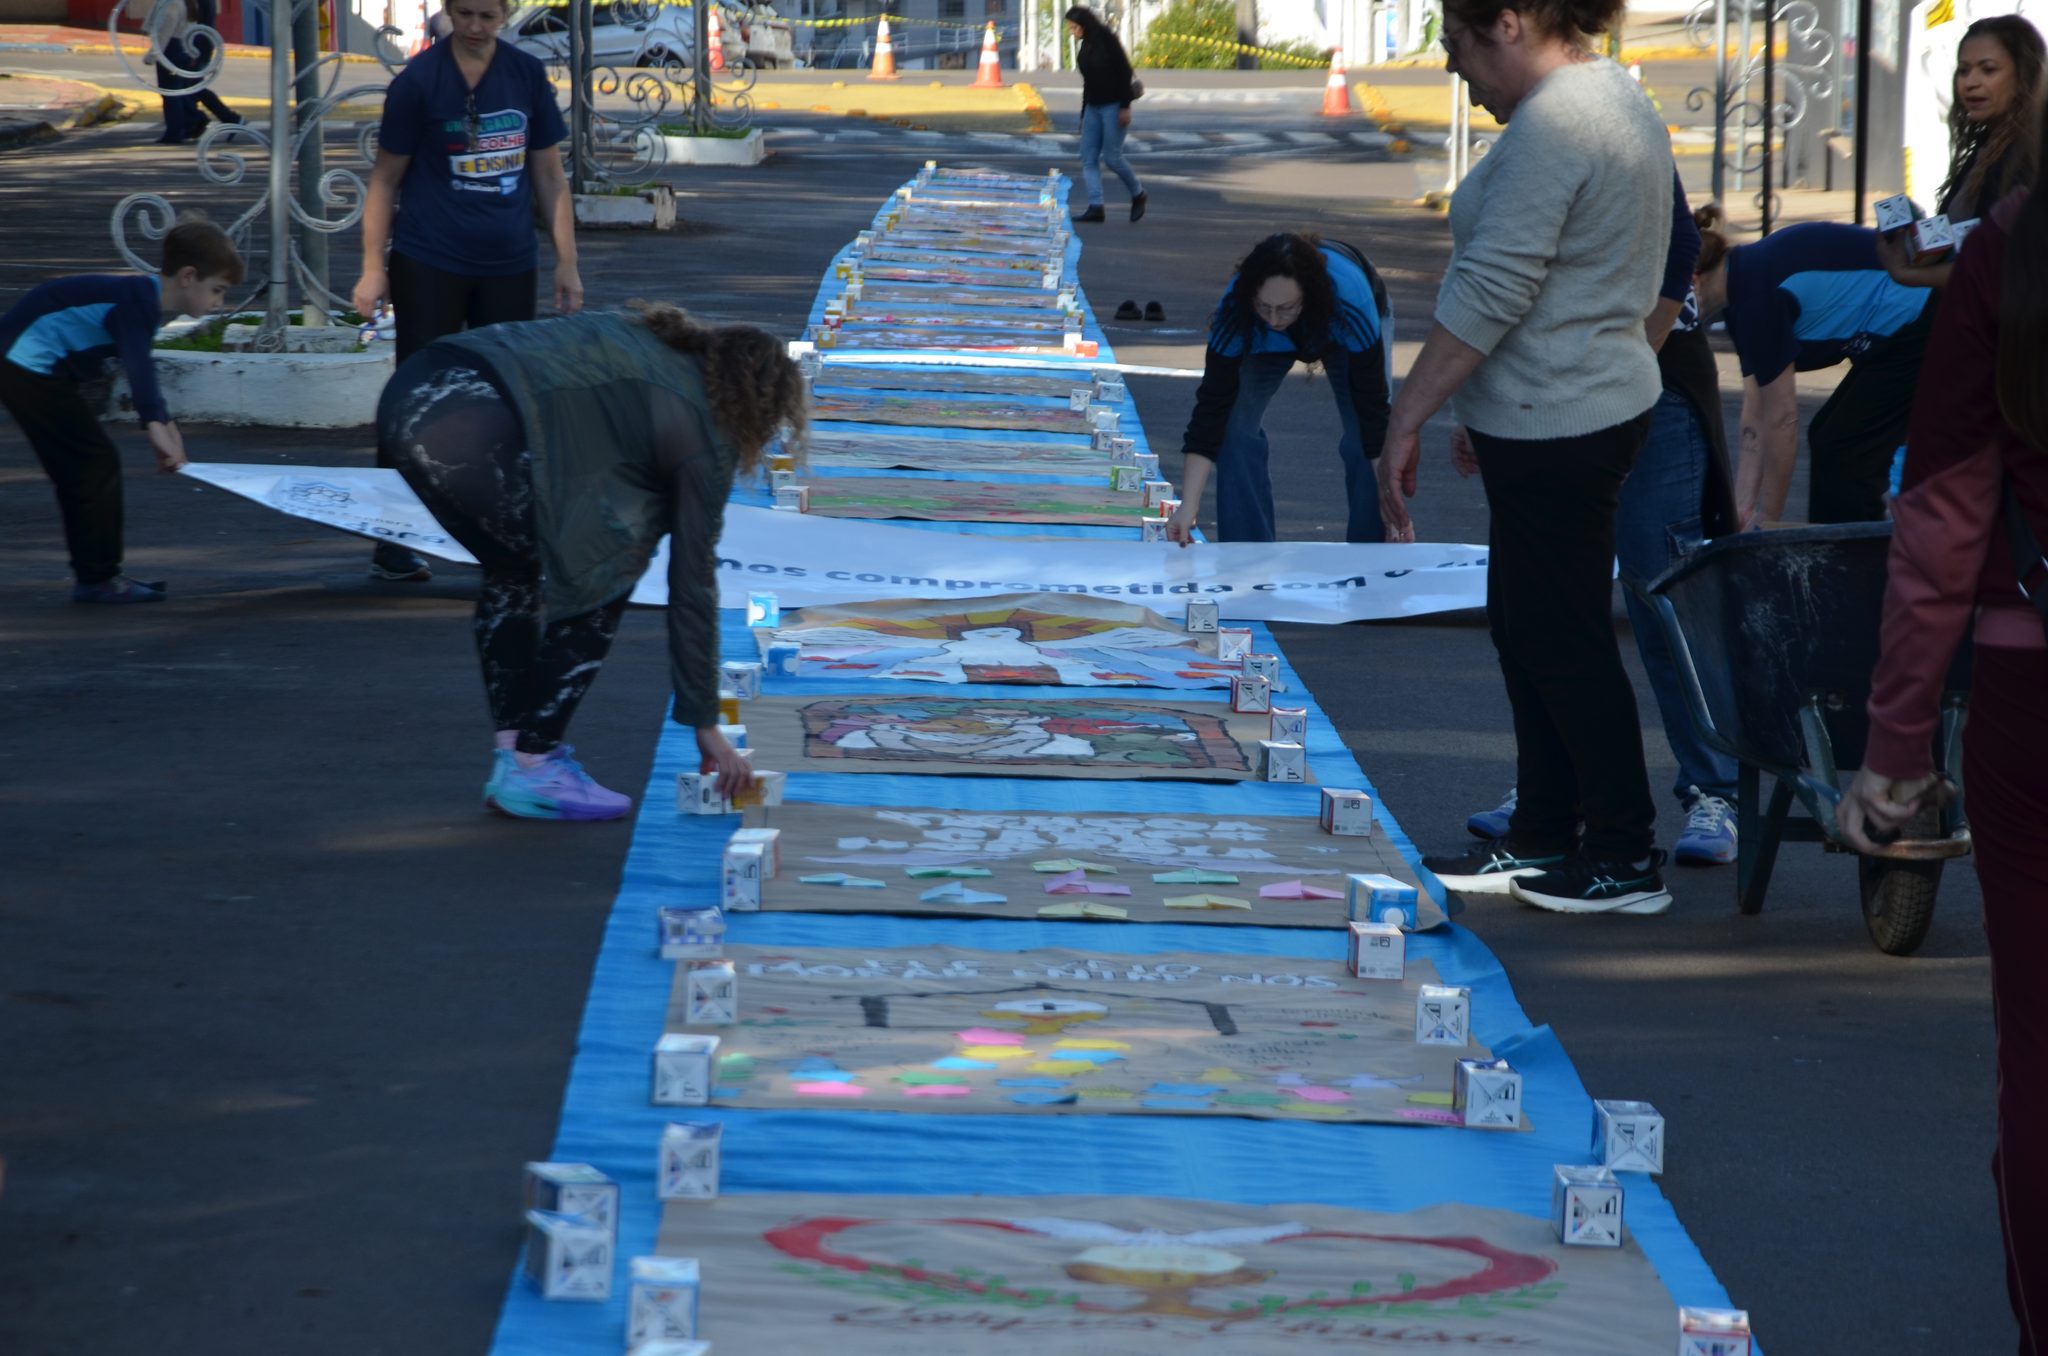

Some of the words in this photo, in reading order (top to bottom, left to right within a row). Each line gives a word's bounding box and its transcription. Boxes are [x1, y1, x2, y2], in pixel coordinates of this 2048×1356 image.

[478, 135, 525, 151] COLHE
[824, 570, 1234, 594] comprometida
[1251, 575, 1367, 592] com
